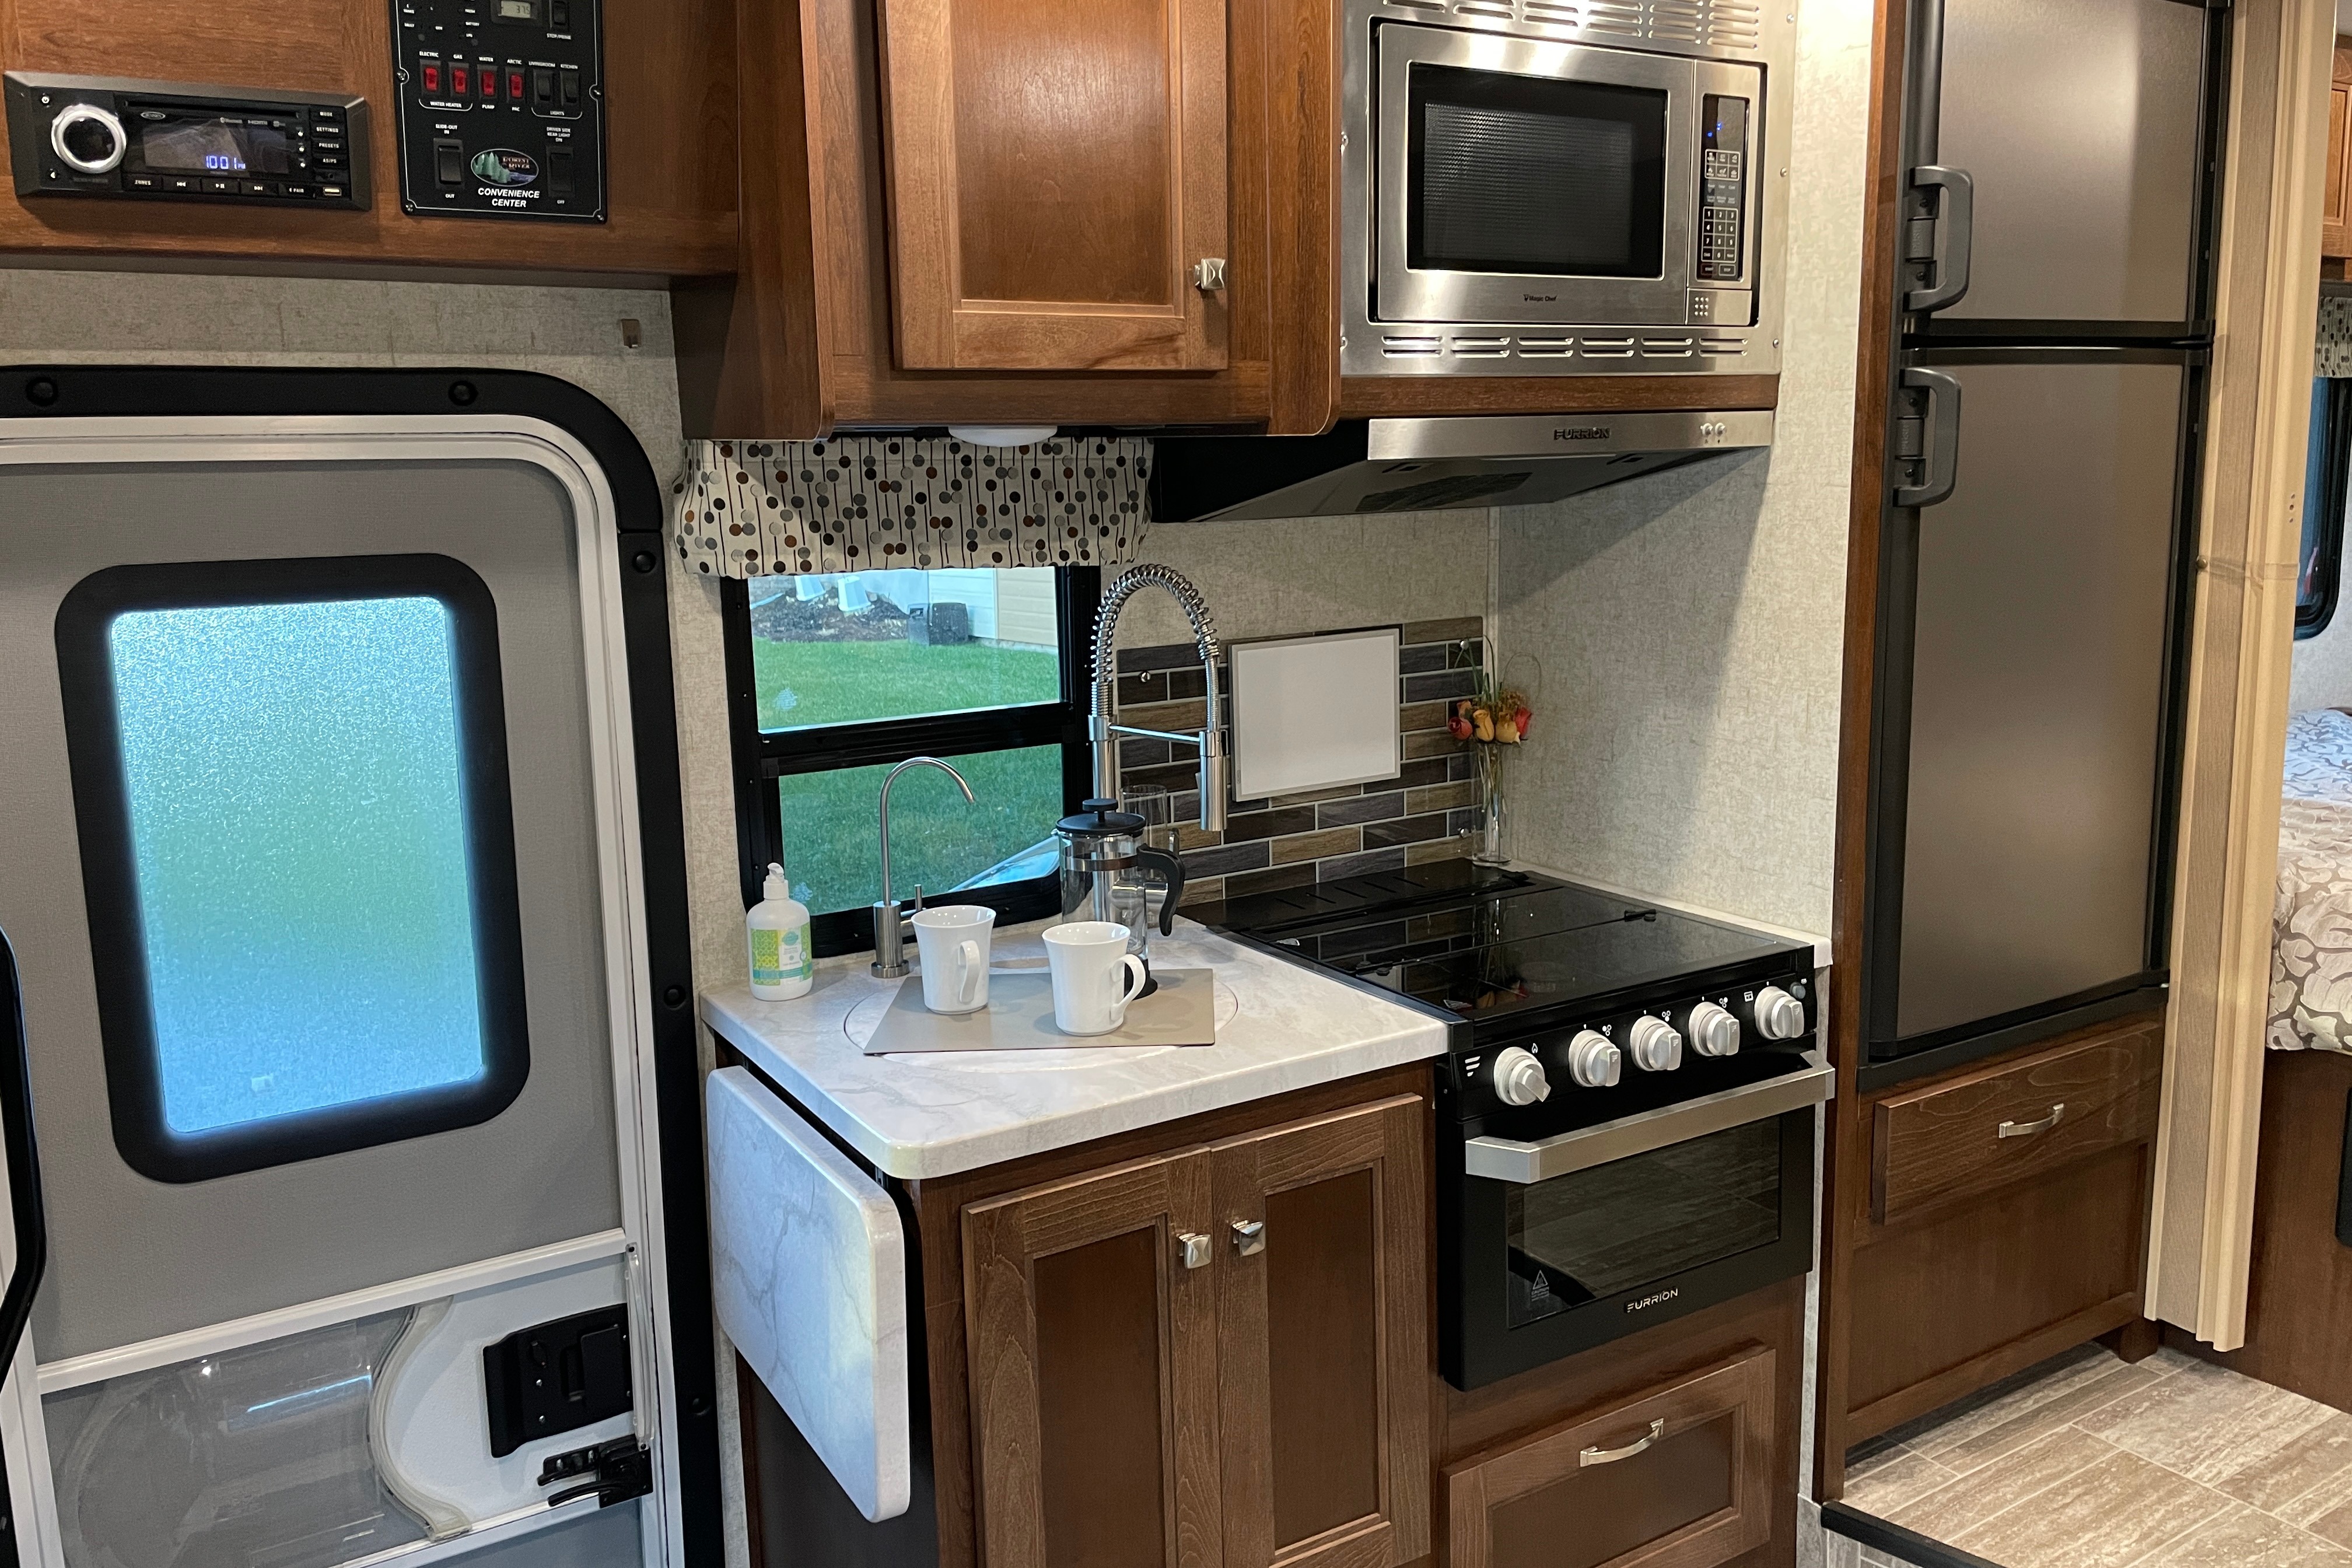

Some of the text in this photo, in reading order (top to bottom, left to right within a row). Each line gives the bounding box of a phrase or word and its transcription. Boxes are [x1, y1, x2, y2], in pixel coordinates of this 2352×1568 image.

[478, 187, 540, 199] CONVENIENCE
[492, 198, 527, 208] CENTER
[1553, 428, 1611, 441] FURRION
[1626, 1287, 1679, 1313] FURRION
